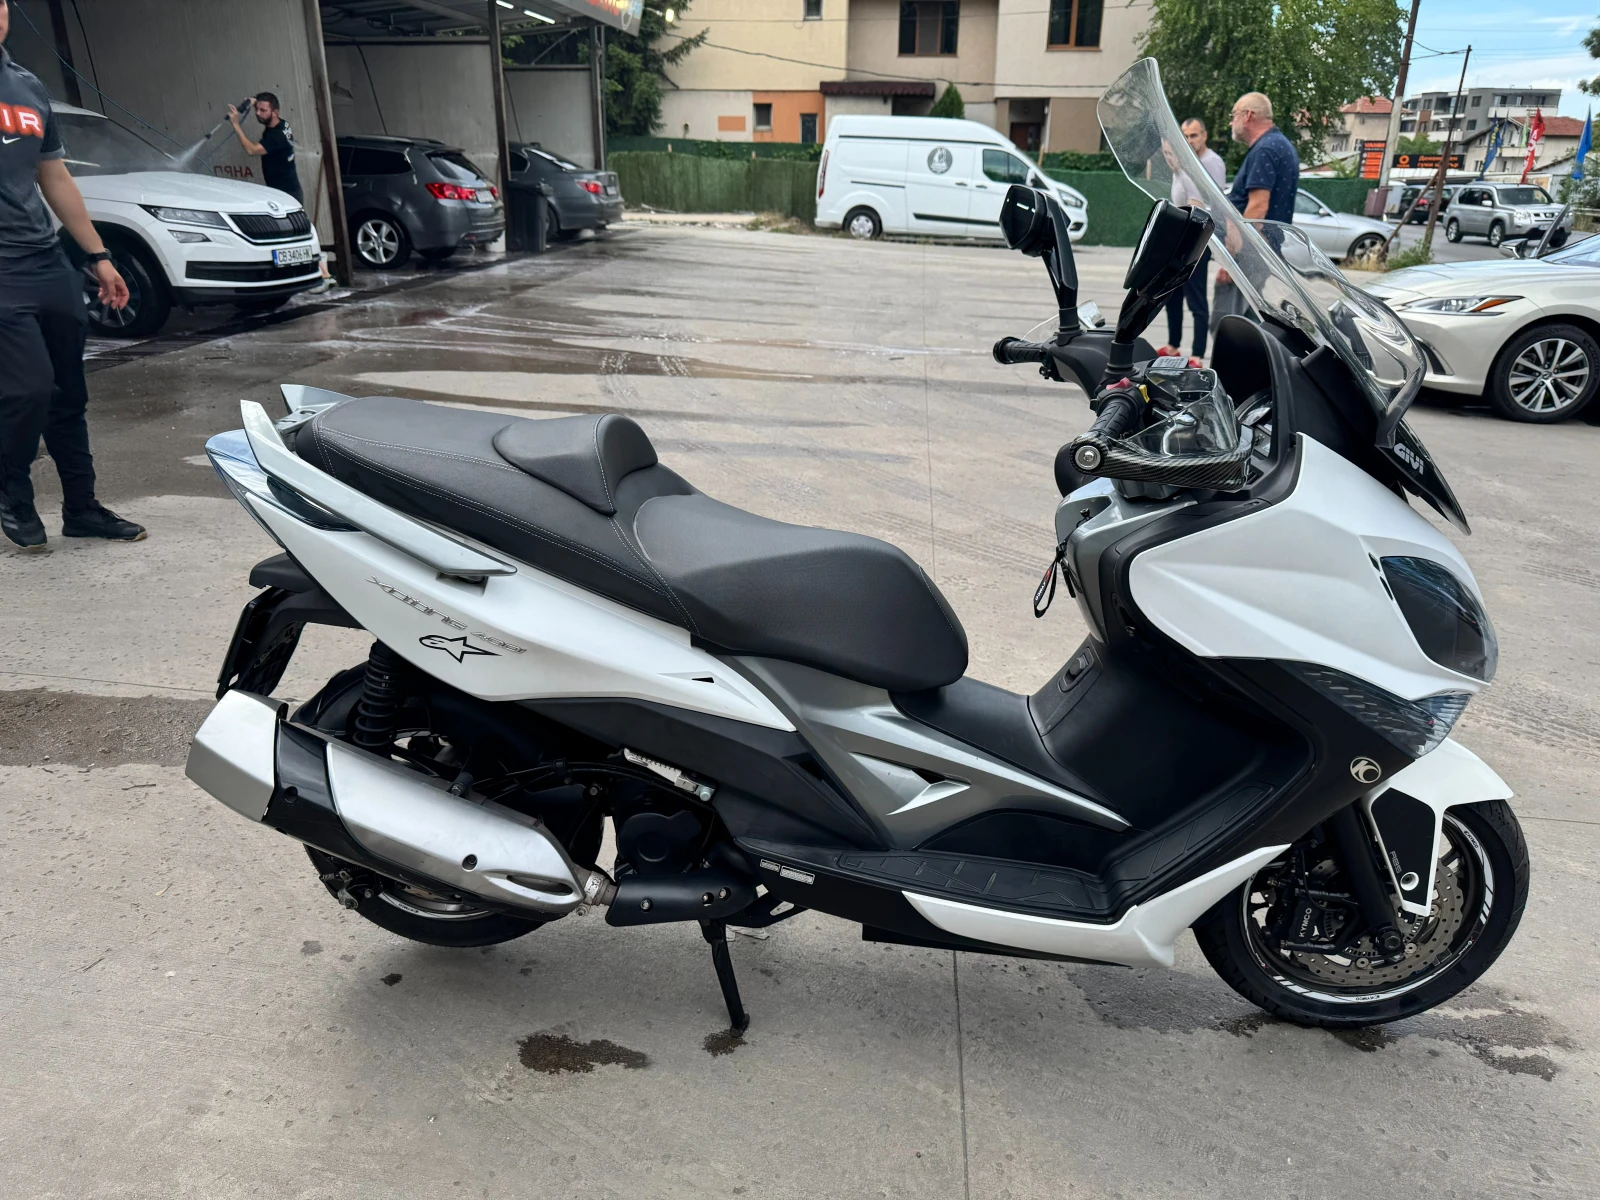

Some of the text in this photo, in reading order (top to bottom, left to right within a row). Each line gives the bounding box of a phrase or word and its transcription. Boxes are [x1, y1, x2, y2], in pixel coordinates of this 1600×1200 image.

[1393, 442, 1424, 475] GIVI
[1389, 850, 1402, 874] ABS
[1298, 907, 1312, 938] KYMCO
